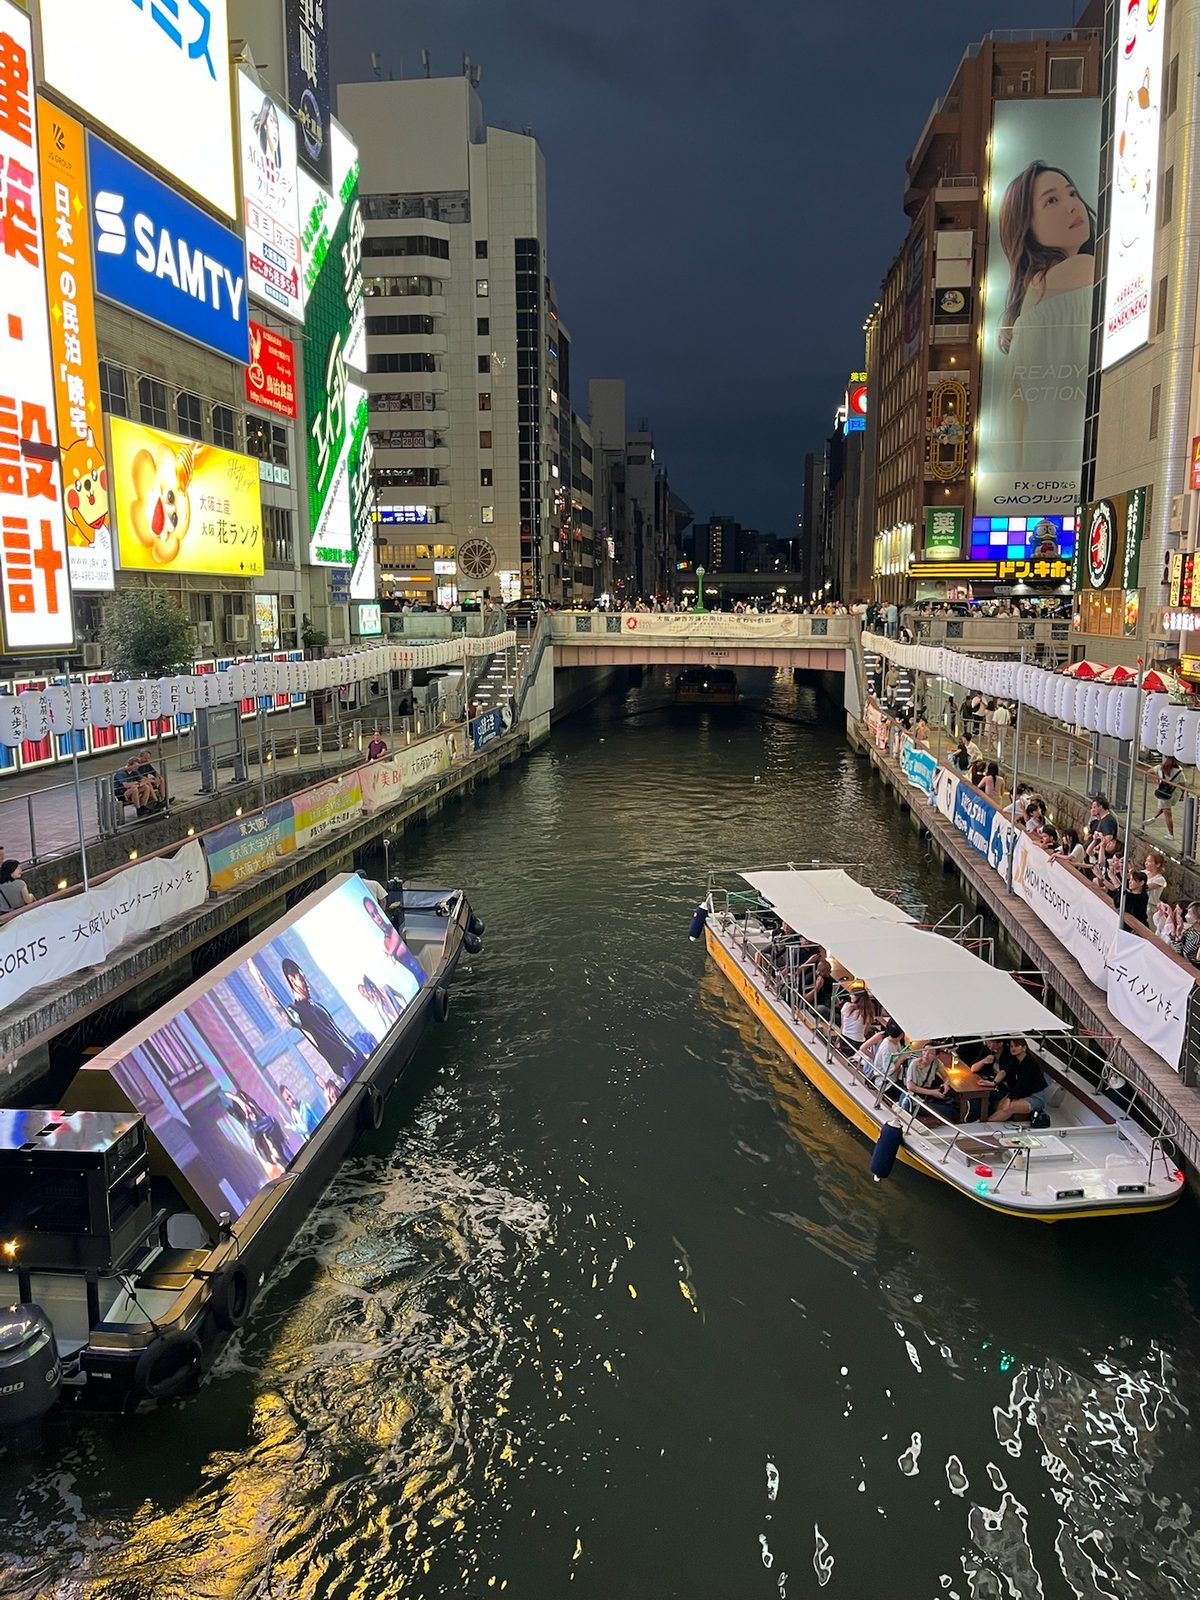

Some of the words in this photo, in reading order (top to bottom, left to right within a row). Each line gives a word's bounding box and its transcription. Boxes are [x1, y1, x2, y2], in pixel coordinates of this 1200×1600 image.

[134, 210, 244, 322] SAMTY
[1107, 294, 1149, 334] MANEKINEKO
[1013, 364, 1087, 379] READY
[1010, 386, 1087, 401] ACTION
[200, 496, 231, 515] 大阪土産
[217, 519, 259, 547] 花ラング
[933, 512, 955, 534] 薬
[150, 685, 160, 714] MASATO
[170, 685, 179, 712] REI
